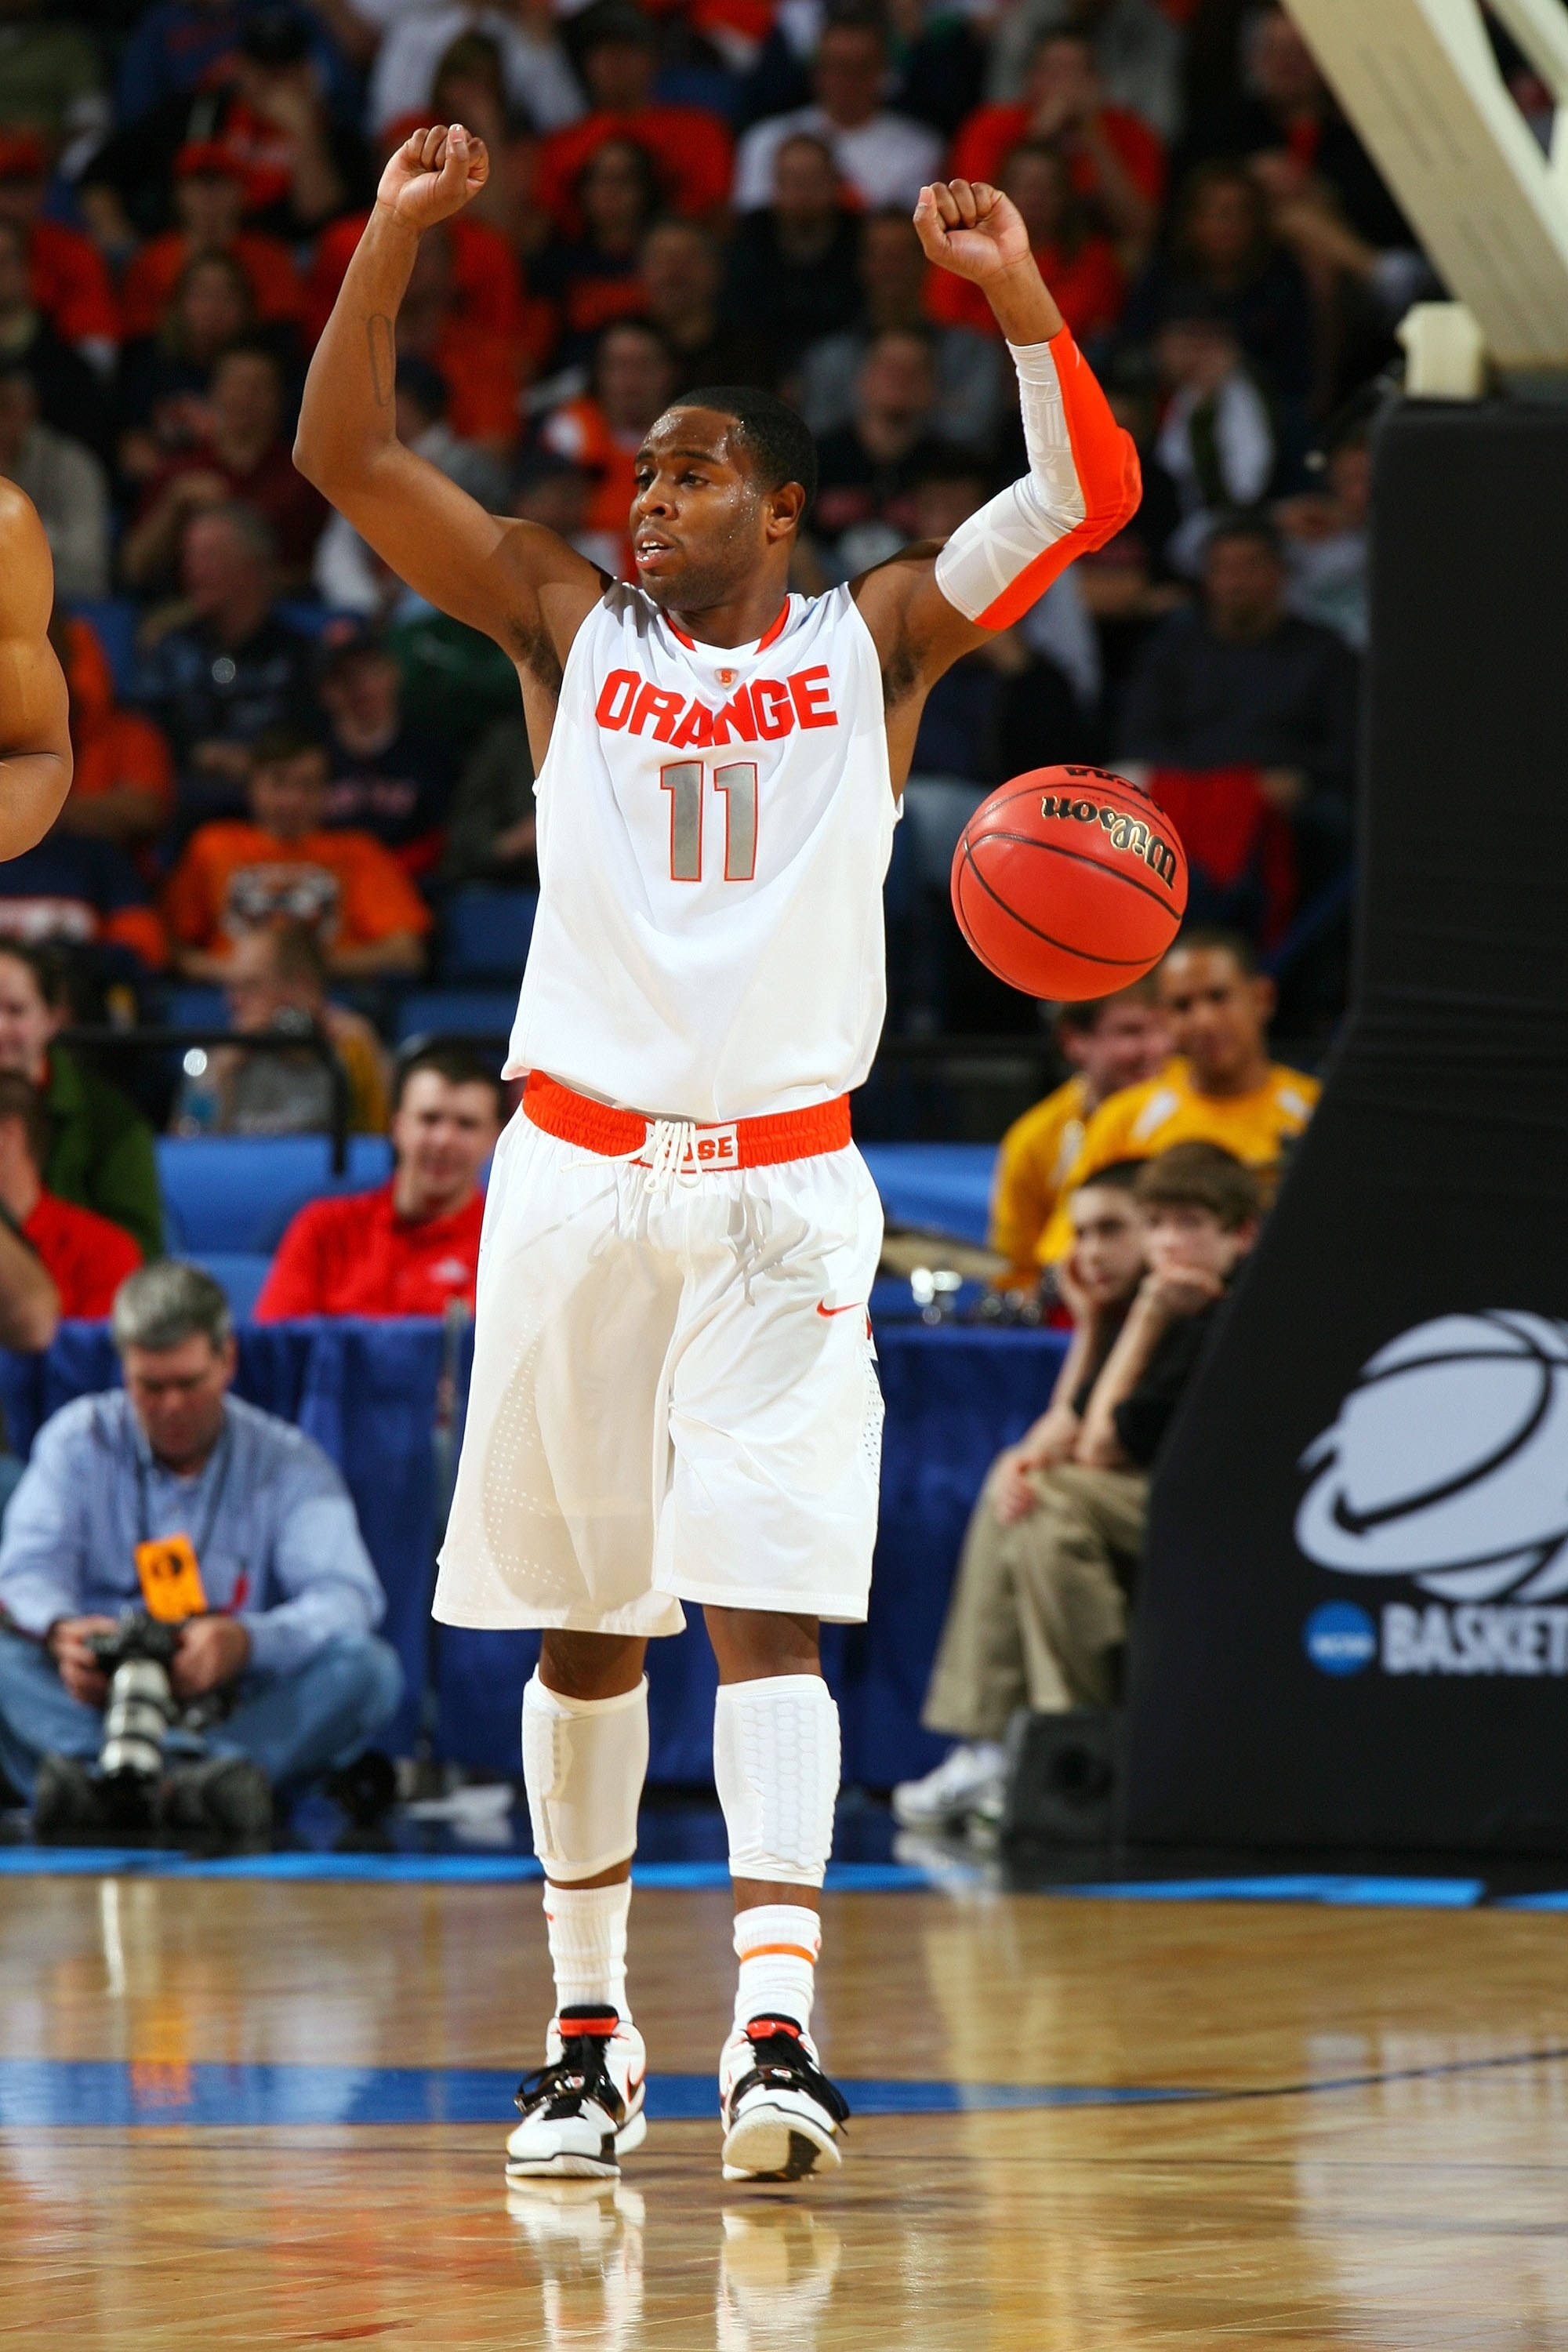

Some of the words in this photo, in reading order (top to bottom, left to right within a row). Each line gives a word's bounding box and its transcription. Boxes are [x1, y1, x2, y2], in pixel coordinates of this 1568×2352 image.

[595, 664, 839, 749] ORANGE
[660, 760, 758, 882] 11
[1041, 795, 1176, 890] Wilson
